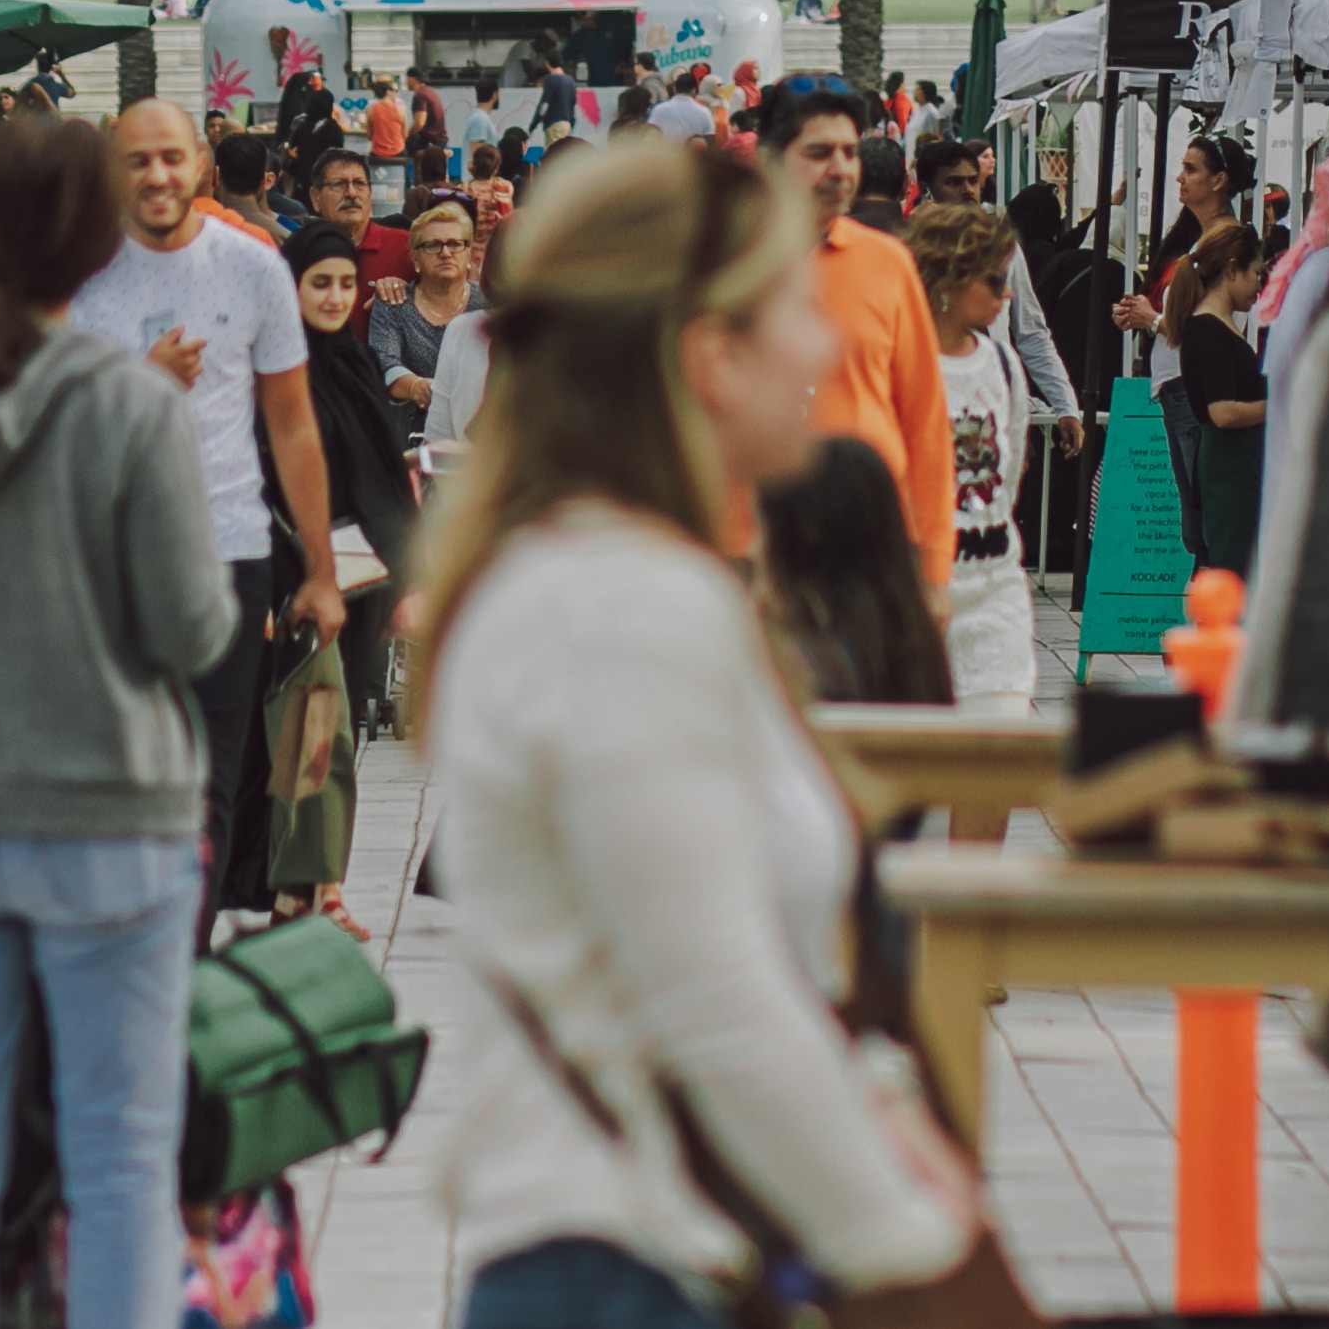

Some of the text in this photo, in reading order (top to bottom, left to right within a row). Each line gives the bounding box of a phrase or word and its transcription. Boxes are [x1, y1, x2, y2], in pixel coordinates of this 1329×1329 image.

[1136, 475, 1168, 484] forever
[1130, 503, 1143, 512] for
[1152, 502, 1178, 512] better
[1137, 531, 1152, 540] the
[1134, 546, 1181, 555] turn me on
[1130, 572, 1177, 583] KOOLADE
[1117, 615, 1179, 626] mellow yellow
